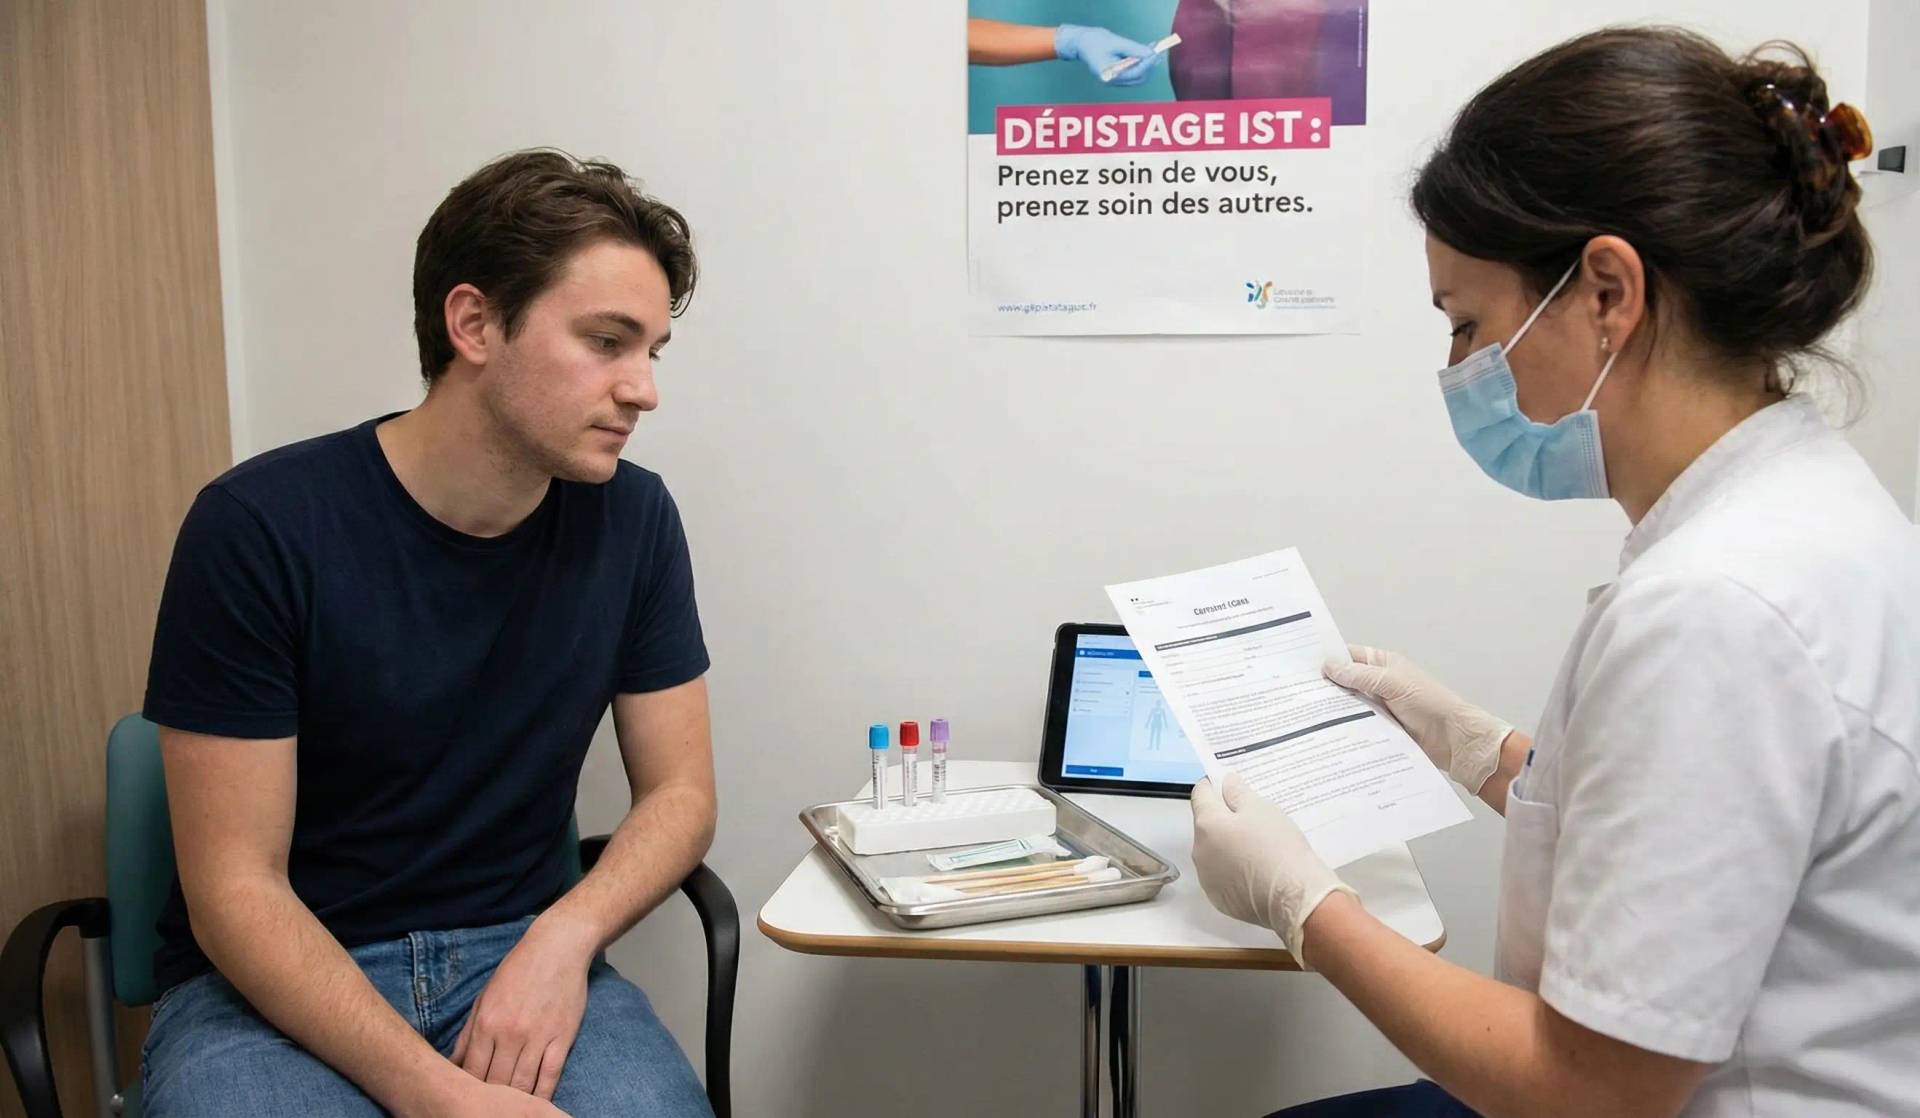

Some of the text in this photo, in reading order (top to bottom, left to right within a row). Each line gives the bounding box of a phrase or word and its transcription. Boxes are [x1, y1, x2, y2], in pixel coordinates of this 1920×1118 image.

[1004, 109, 1225, 149] DÉPISTAGE
[1239, 111, 1303, 144] IST
[998, 160, 1277, 187] Prenez soin de vous,
[998, 191, 1313, 224] prenez soin des autres.
